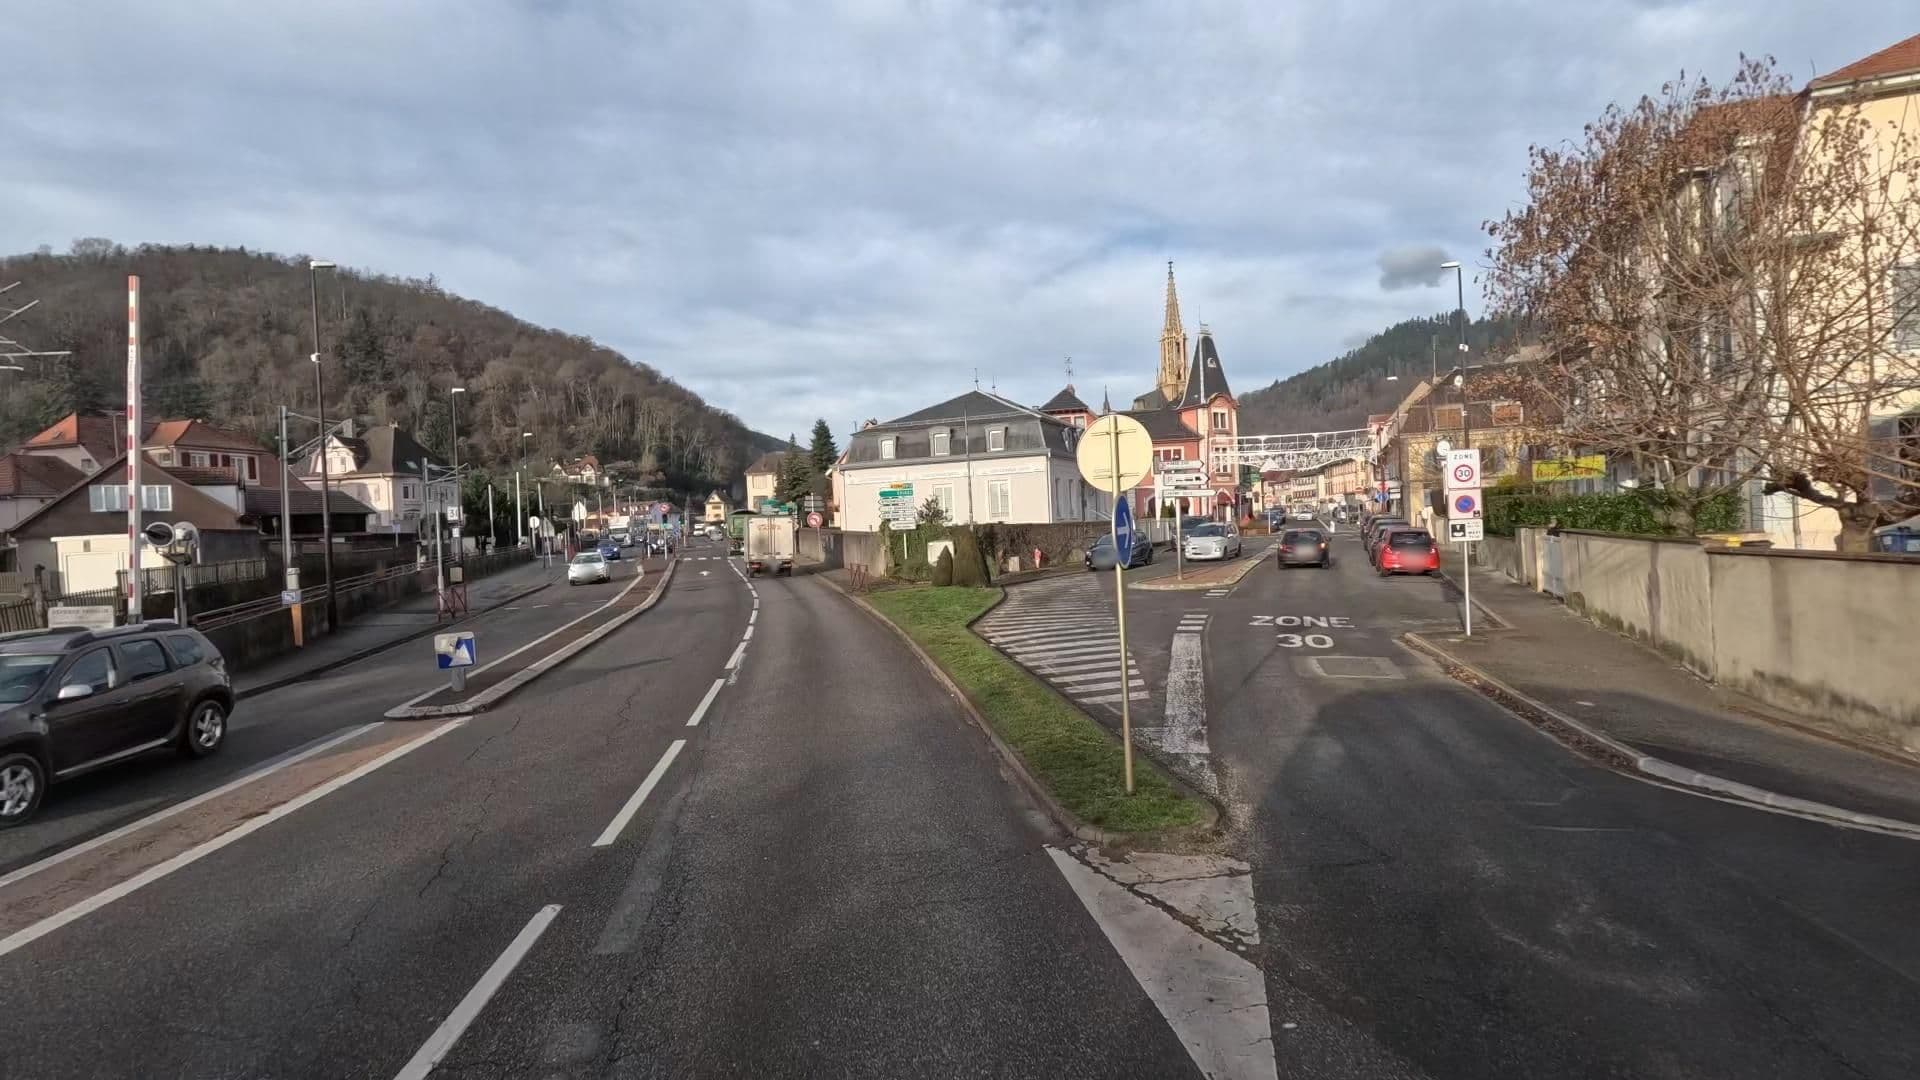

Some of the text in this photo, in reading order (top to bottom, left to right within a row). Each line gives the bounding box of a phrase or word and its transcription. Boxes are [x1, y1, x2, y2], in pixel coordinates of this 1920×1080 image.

[1458, 469, 1470, 477] 30
[1248, 615, 1355, 628] ZONE
[1276, 633, 1334, 648] 30
